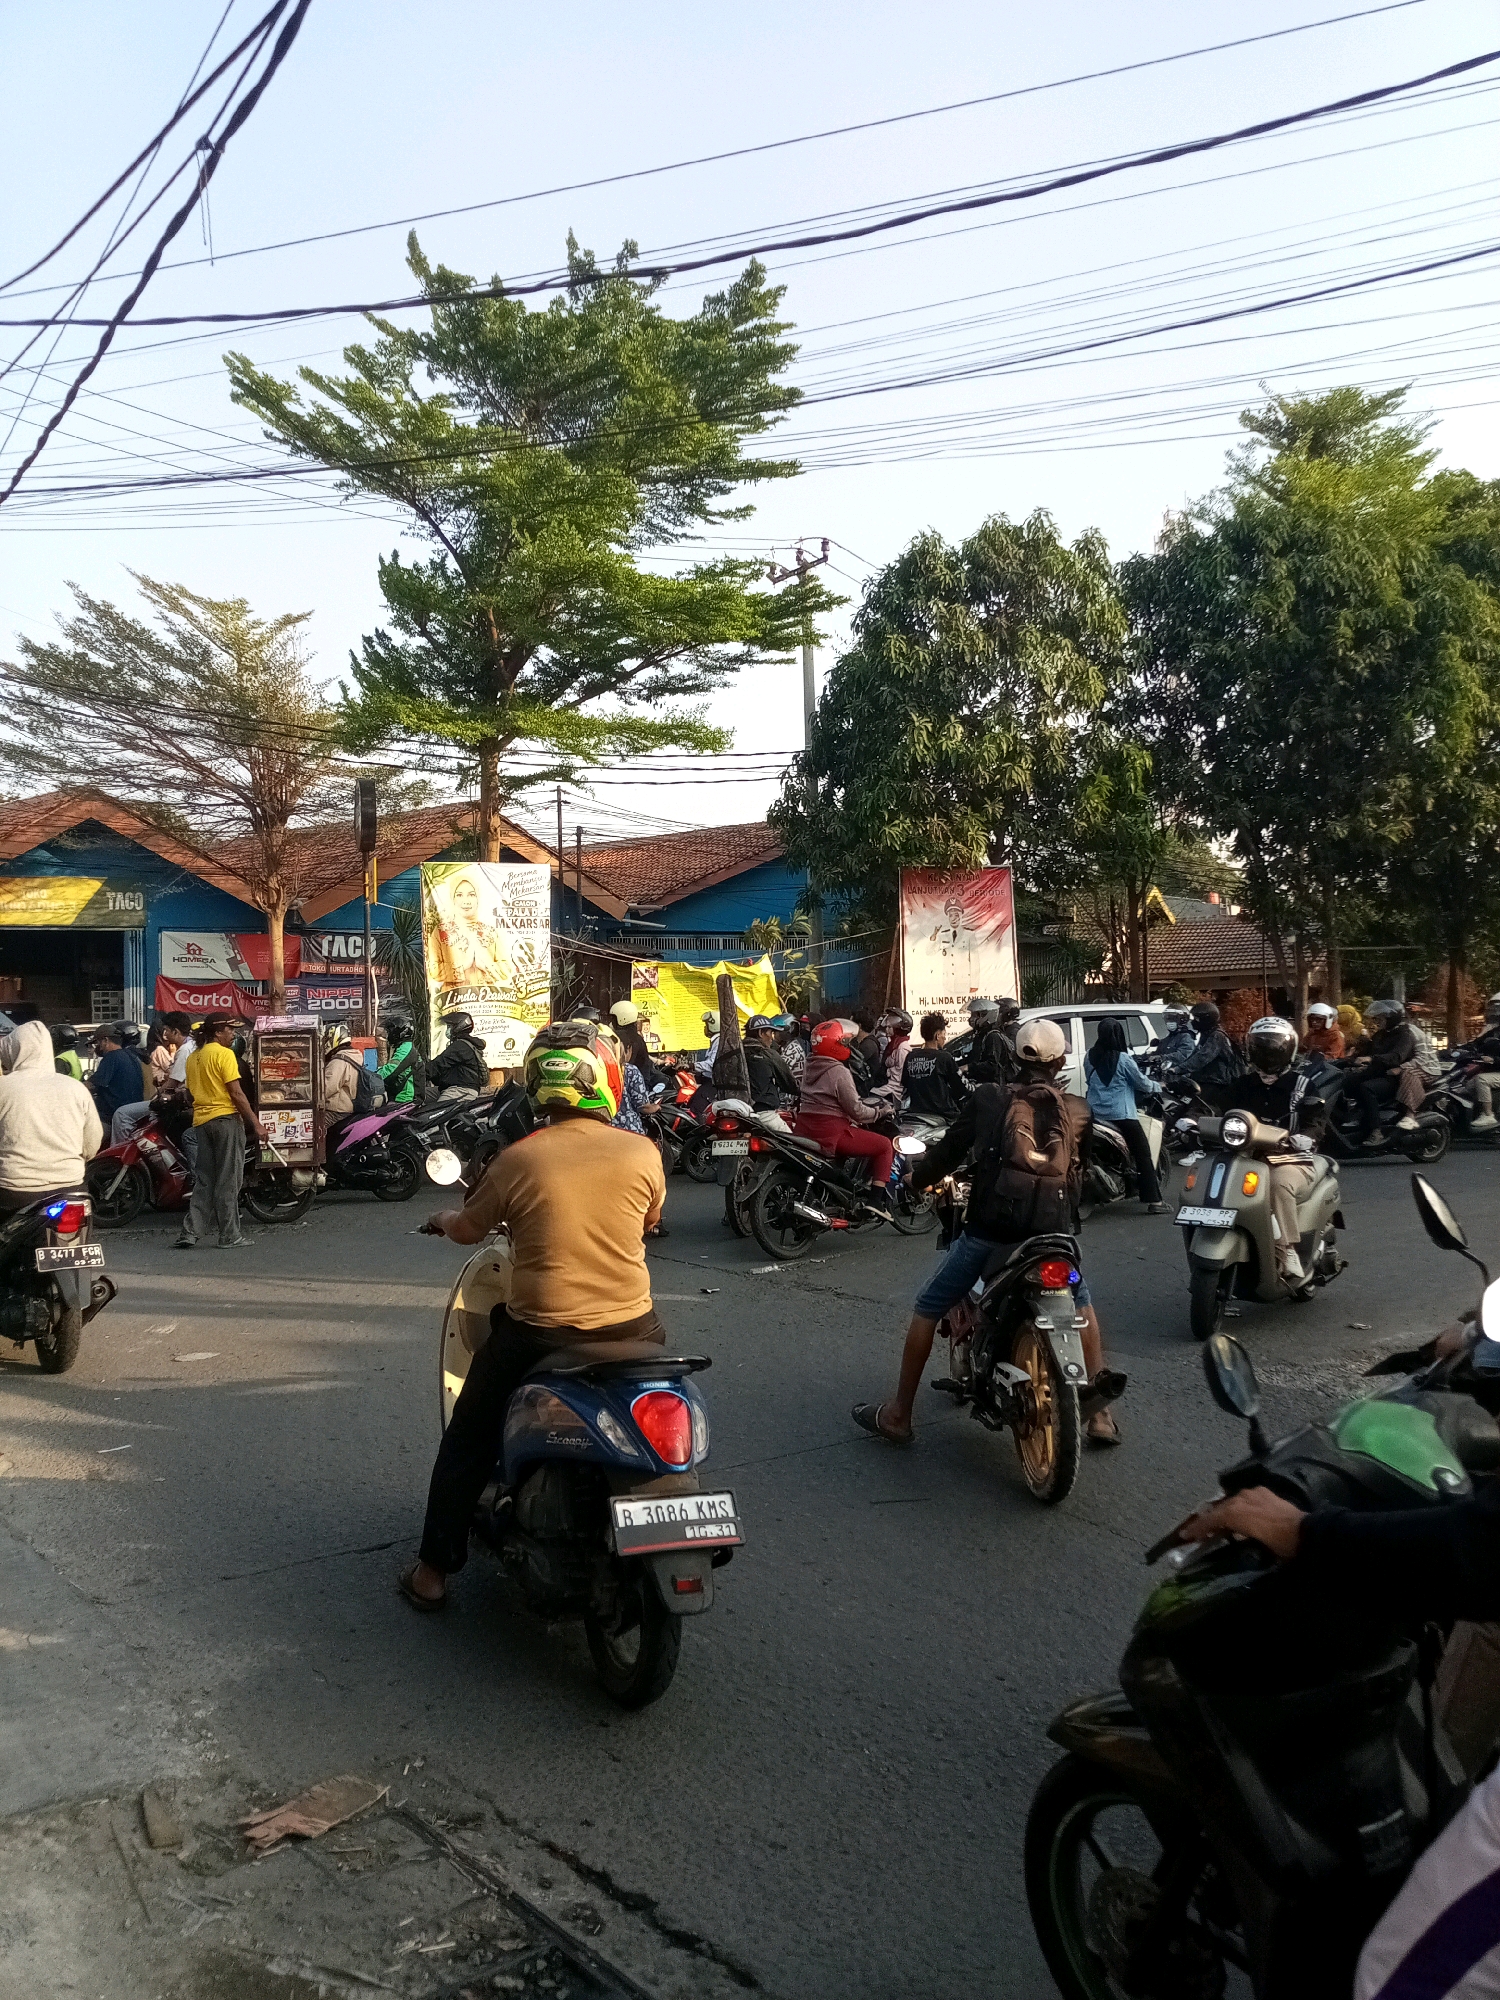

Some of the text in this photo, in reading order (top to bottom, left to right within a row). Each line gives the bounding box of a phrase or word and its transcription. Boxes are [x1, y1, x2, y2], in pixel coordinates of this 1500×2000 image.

[907, 883, 1006, 897] LANJUTKAN 3 PERIODE
[106, 891, 144, 911] TACO
[308, 964, 326, 972] TOKO
[174, 989, 233, 1008] Carta
[307, 998, 363, 1011] 2000
[642, 1000, 649, 1010] 2
[931, 996, 955, 1005] LINDA
[38, 1250, 46, 1261] B
[49, 1248, 75, 1260] 3477
[642, 1381, 671, 1389] HONDA
[545, 1431, 594, 1448] Scoopy
[622, 1500, 730, 1527] B 3086 KMS
